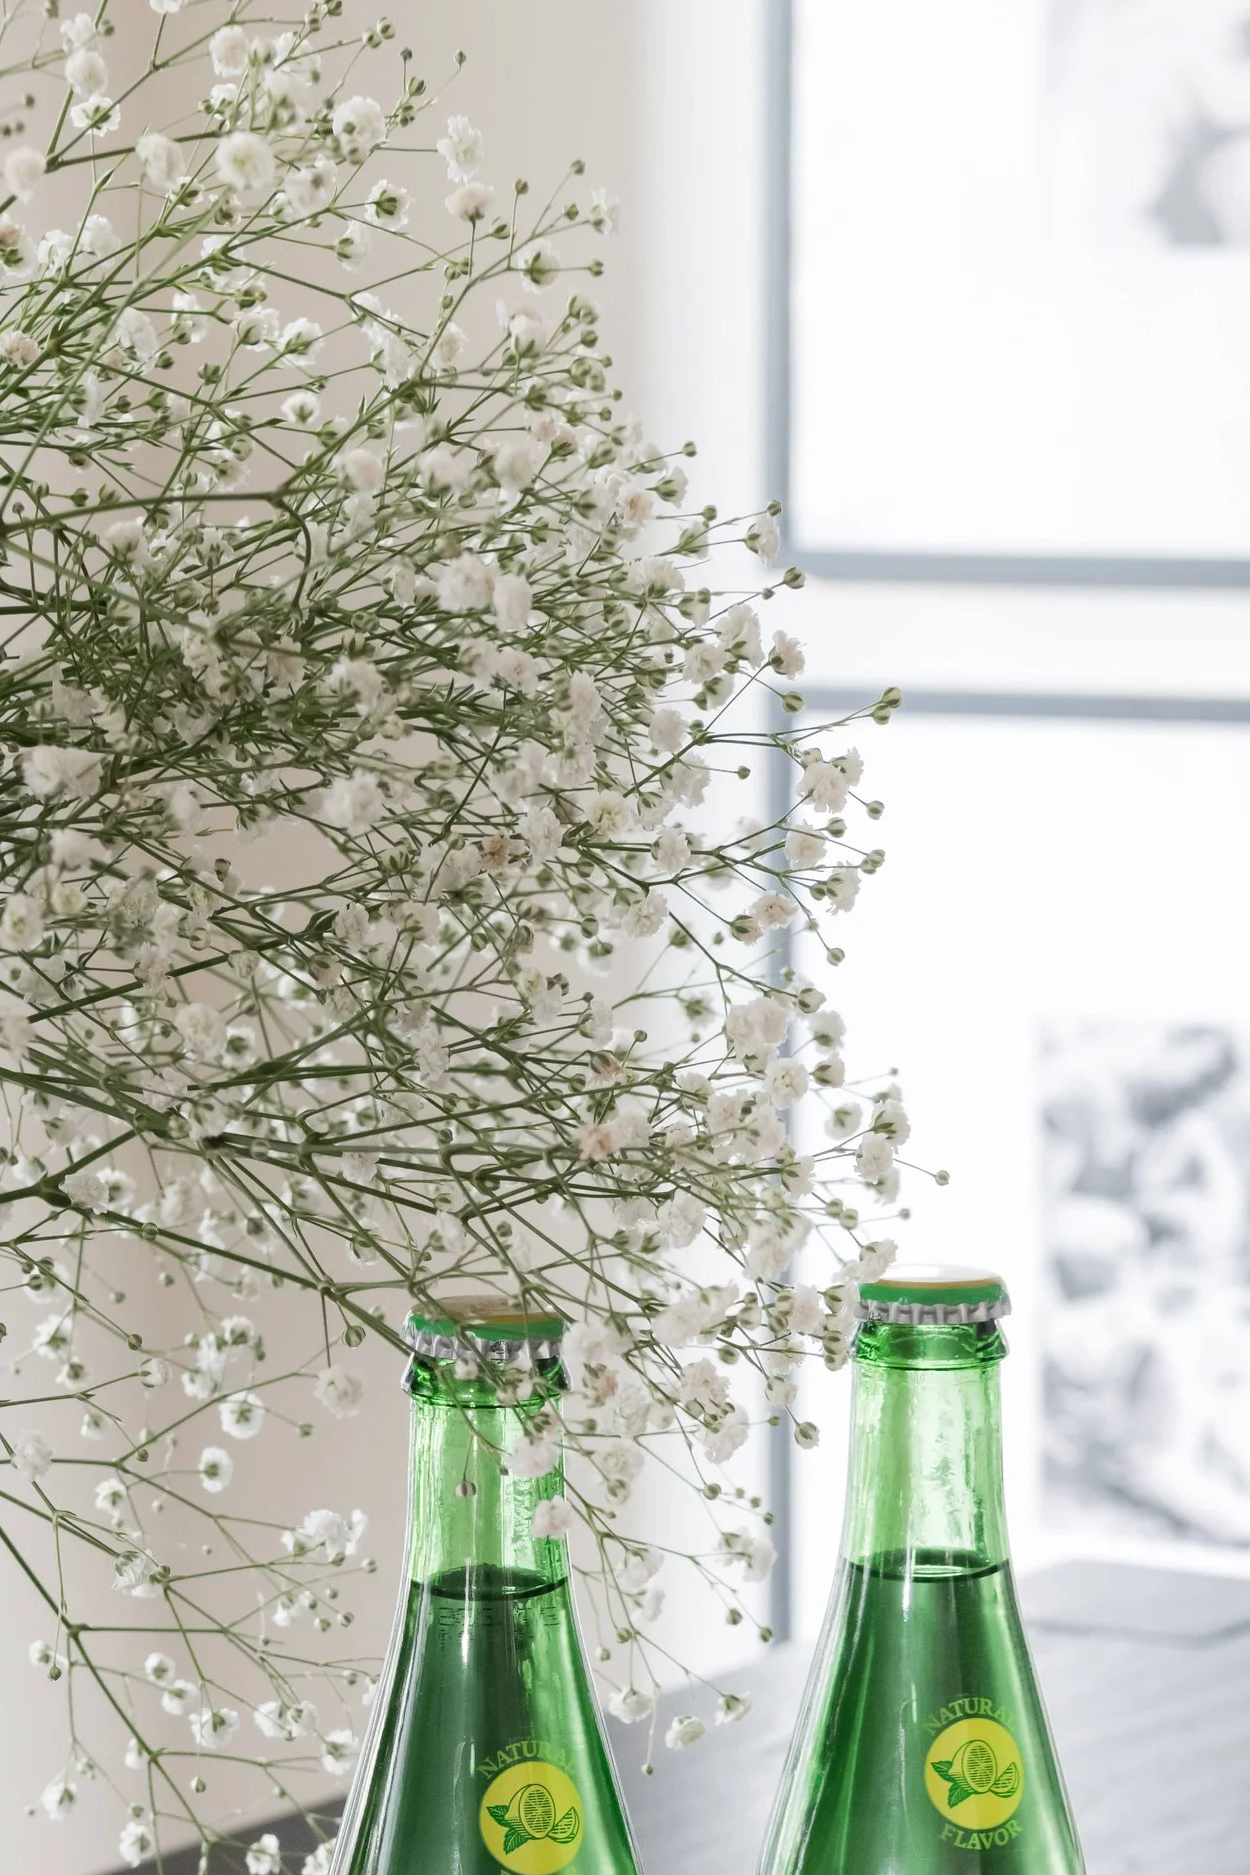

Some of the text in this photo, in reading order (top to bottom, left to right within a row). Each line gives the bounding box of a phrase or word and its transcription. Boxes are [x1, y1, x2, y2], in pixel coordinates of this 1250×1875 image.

[924, 1697, 1015, 1736] NATURAL
[476, 1741, 577, 1780] NATURAL
[940, 1819, 1023, 1850] FLAVOR
